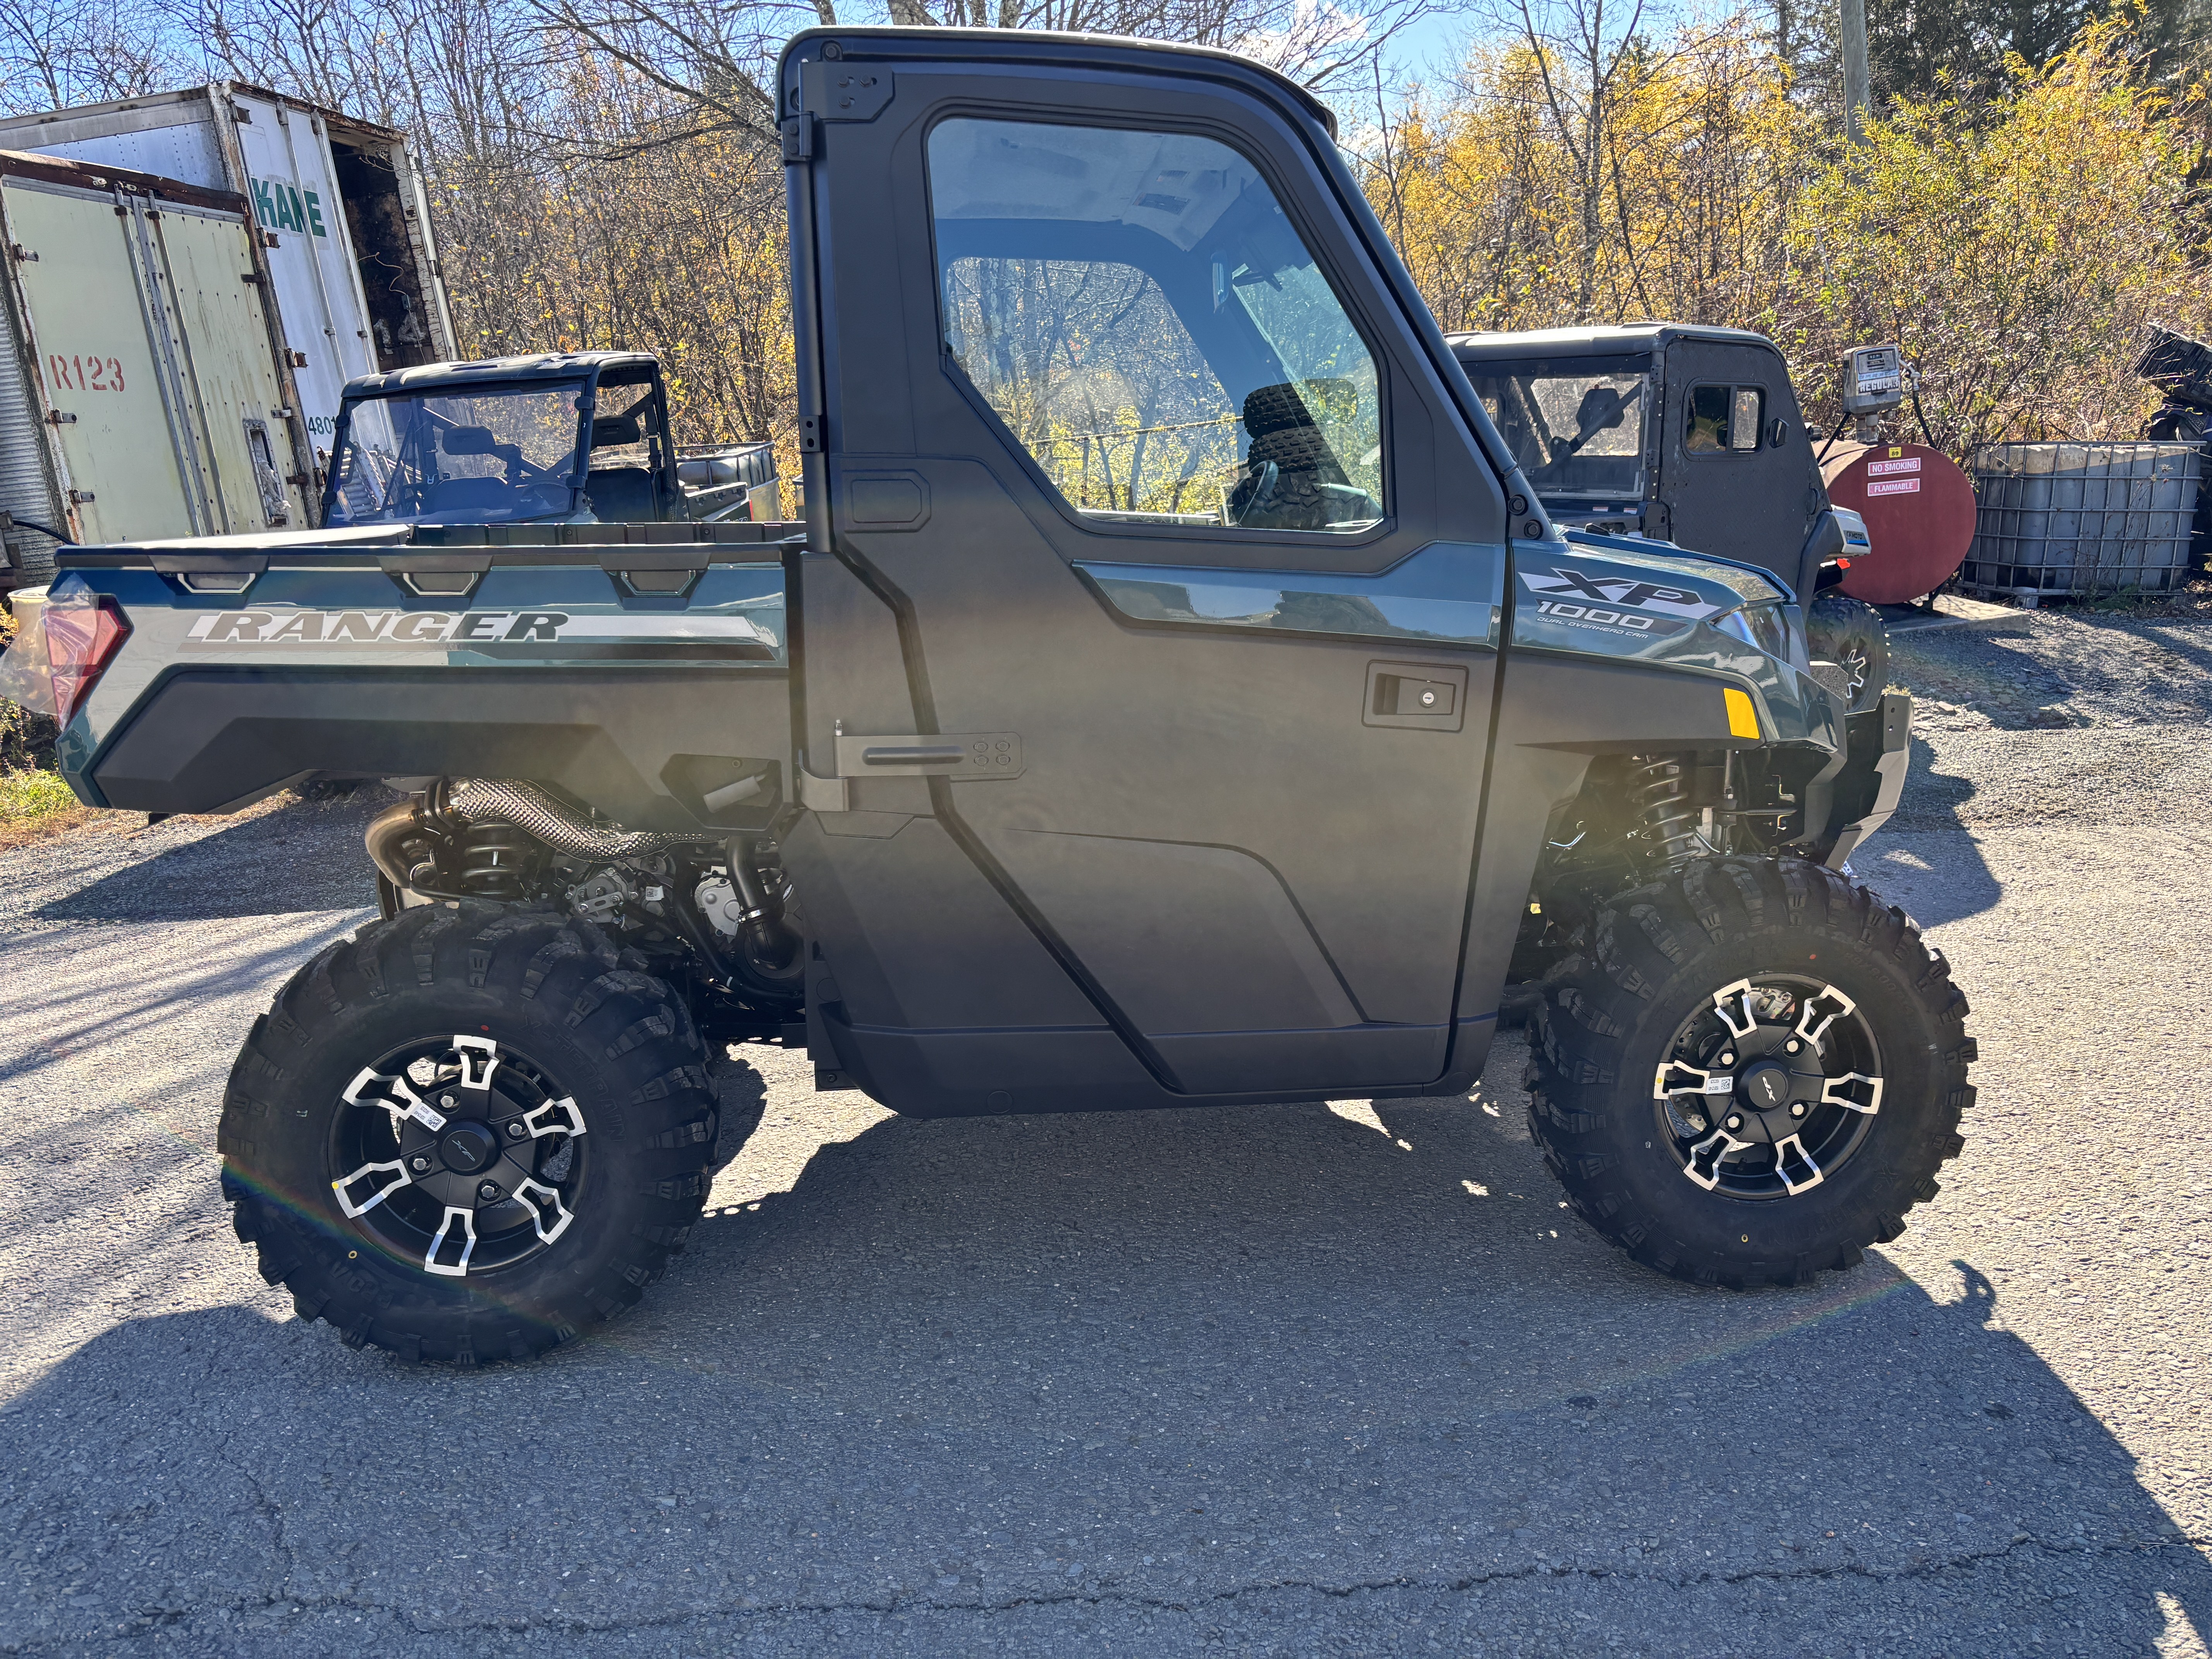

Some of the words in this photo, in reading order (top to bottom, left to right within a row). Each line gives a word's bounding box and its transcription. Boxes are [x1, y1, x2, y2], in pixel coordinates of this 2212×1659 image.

[251, 178, 327, 238] KANE
[50, 355, 125, 392] R123
[1860, 377, 1900, 392] REGULAR
[1872, 464, 1882, 472] NO
[1885, 460, 1917, 472] SMOKING
[1874, 482, 1913, 493] FLAMMABLE
[1532, 568, 1704, 606] XP
[202, 610, 568, 642] RANGER
[1537, 601, 1654, 630] 1000
[1537, 617, 1565, 625] DUAL
[1568, 621, 1624, 635] OVERHEAD
[1625, 631, 1649, 639] CAM
[1762, 1077, 1776, 1101] XP
[452, 1140, 476, 1162] XP
